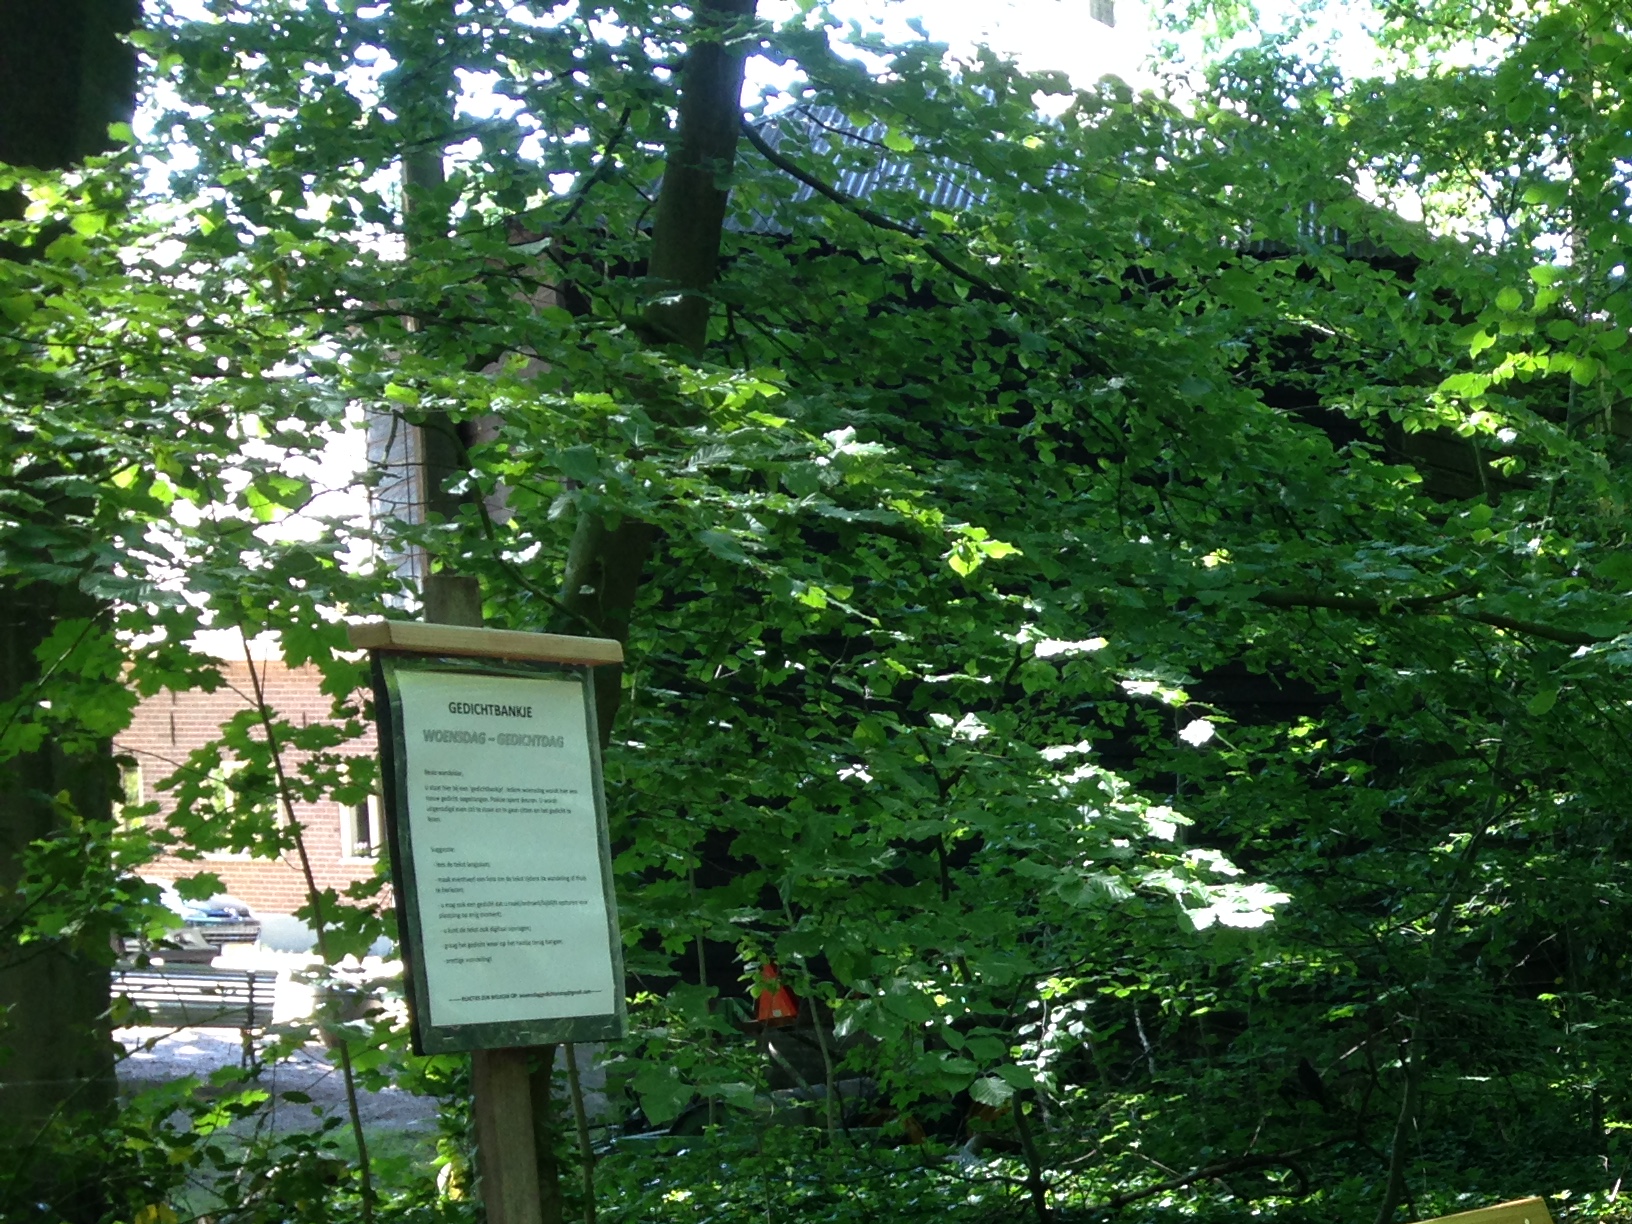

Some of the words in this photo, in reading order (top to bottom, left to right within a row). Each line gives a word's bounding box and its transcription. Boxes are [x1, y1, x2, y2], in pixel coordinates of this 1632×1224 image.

[448, 701, 533, 718] GEDICHTBANKJE
[423, 729, 486, 745] WOENSDAG
[497, 733, 564, 749] GEDICHTDAG
